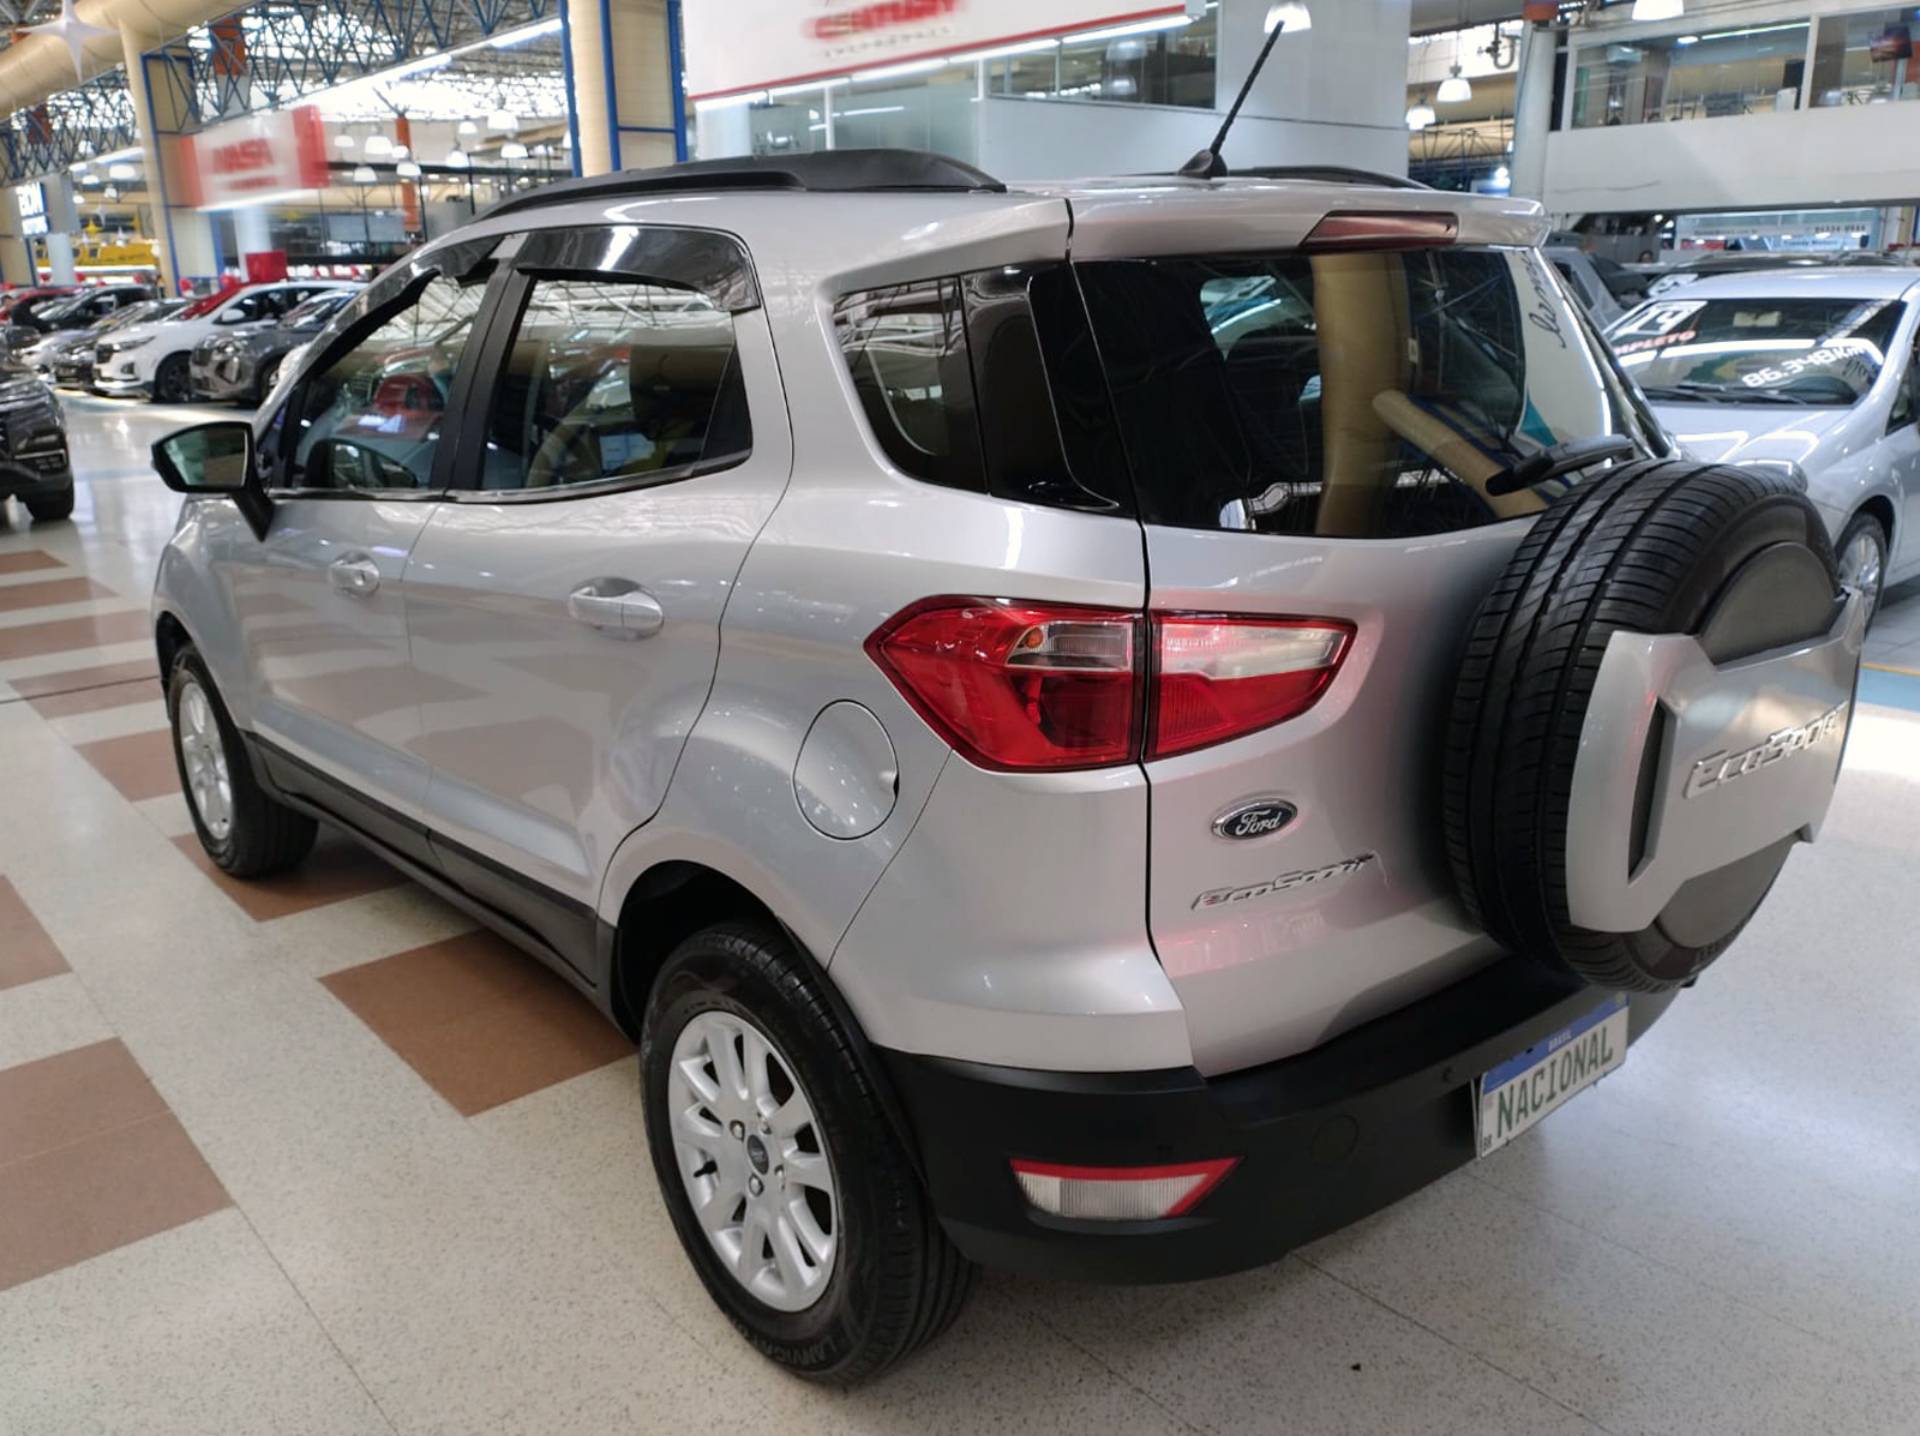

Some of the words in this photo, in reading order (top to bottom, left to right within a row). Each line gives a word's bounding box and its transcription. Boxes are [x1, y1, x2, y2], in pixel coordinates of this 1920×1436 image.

[1612, 329, 1697, 355] MPLETO
[1234, 808, 1284, 836] Ford
[1497, 1026, 1614, 1139] NACIONAL
